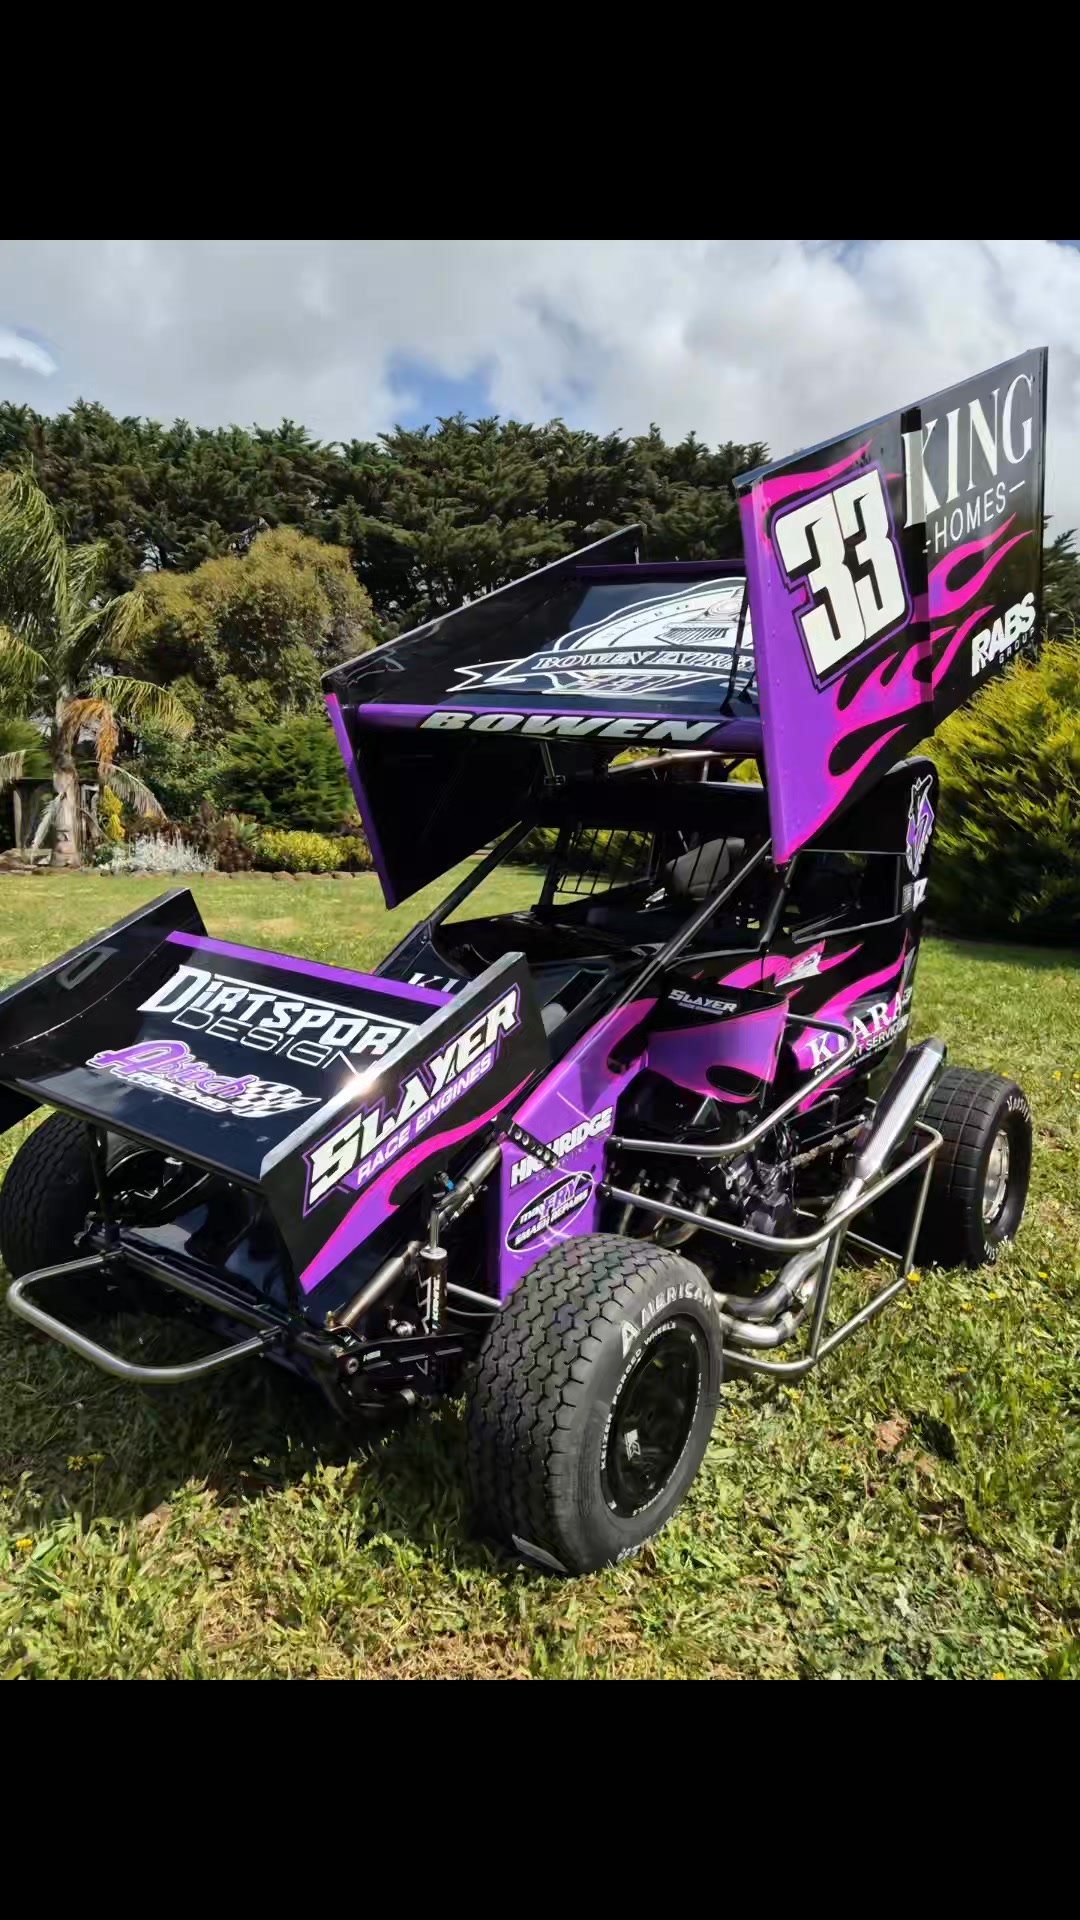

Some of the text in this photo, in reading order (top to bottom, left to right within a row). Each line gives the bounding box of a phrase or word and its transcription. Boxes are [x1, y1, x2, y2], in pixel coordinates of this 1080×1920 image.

[902, 374, 1033, 528] KING
[934, 481, 1006, 553] HOMES
[775, 468, 906, 677] 33
[531, 650, 656, 670] BOWEN
[971, 592, 1036, 677] RABS
[421, 711, 724, 742] BOWEN
[668, 989, 738, 1013] SLAYER
[308, 989, 518, 1205] SLAYER
[356, 1051, 492, 1185] RACE ENGINES
[621, 1281, 712, 1359] AMERICAN
